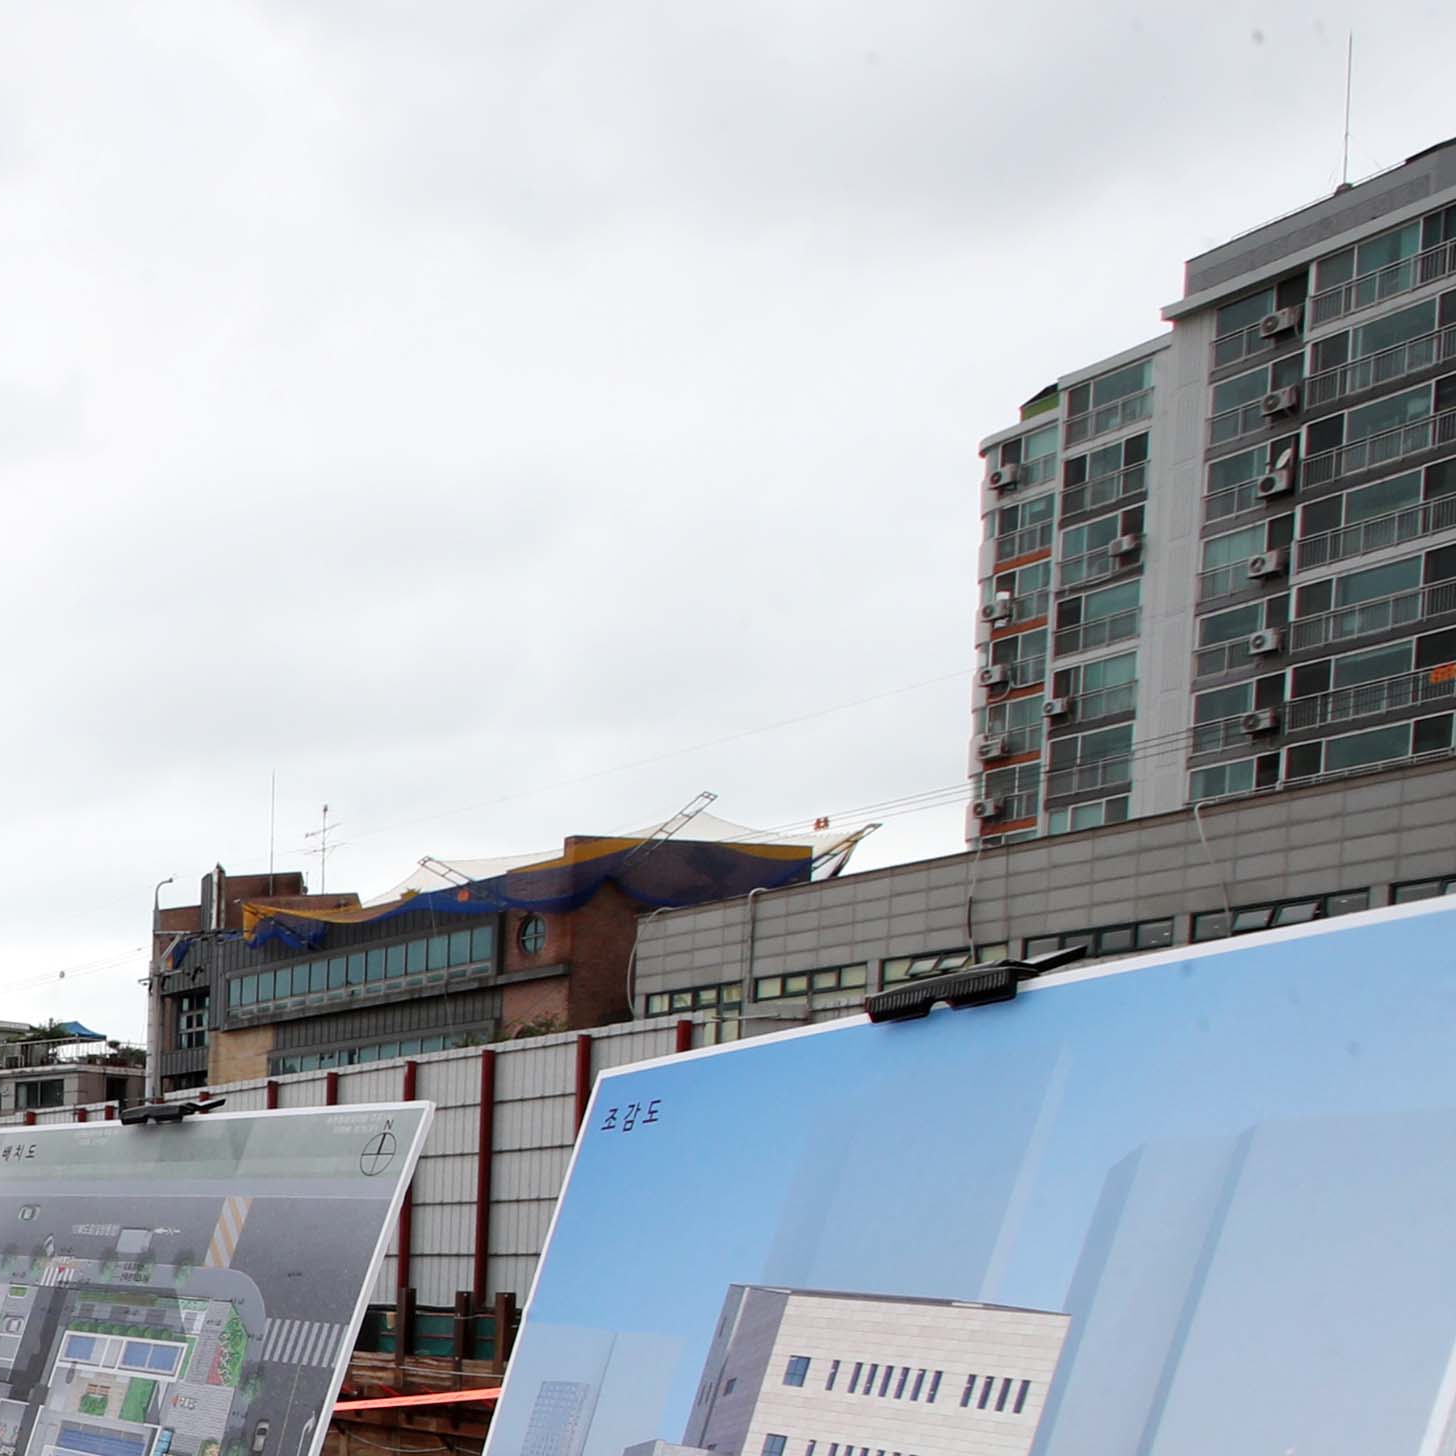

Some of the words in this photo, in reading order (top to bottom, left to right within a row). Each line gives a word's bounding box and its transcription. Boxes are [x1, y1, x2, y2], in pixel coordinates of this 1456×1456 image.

[601, 1100, 662, 1132] 조감도
[384, 1119, 394, 1131] N
[1, 1144, 37, 1161] 배치도
